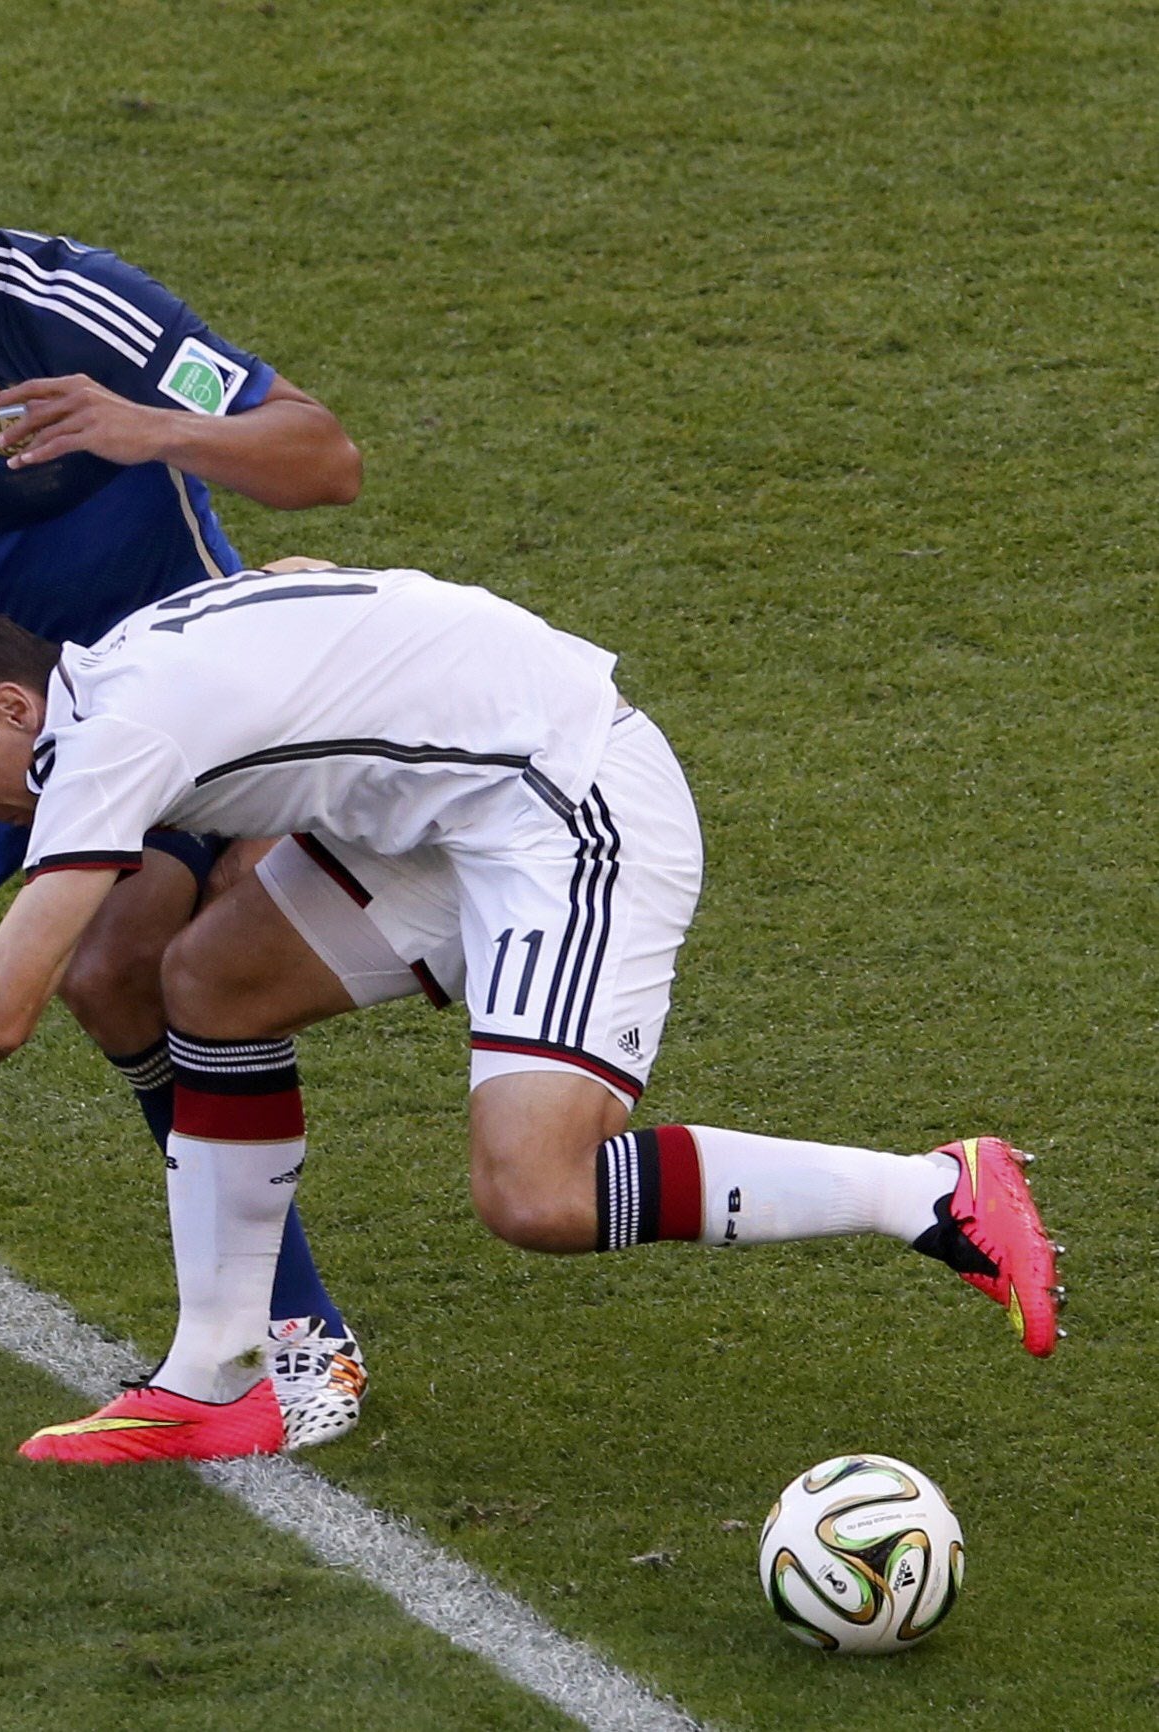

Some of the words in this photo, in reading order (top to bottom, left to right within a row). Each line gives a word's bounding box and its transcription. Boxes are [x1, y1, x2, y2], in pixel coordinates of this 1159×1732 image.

[149, 567, 378, 634] 11
[485, 927, 545, 1016] 11
[617, 1038, 644, 1060] adidas
[893, 1559, 907, 1591] adidas
